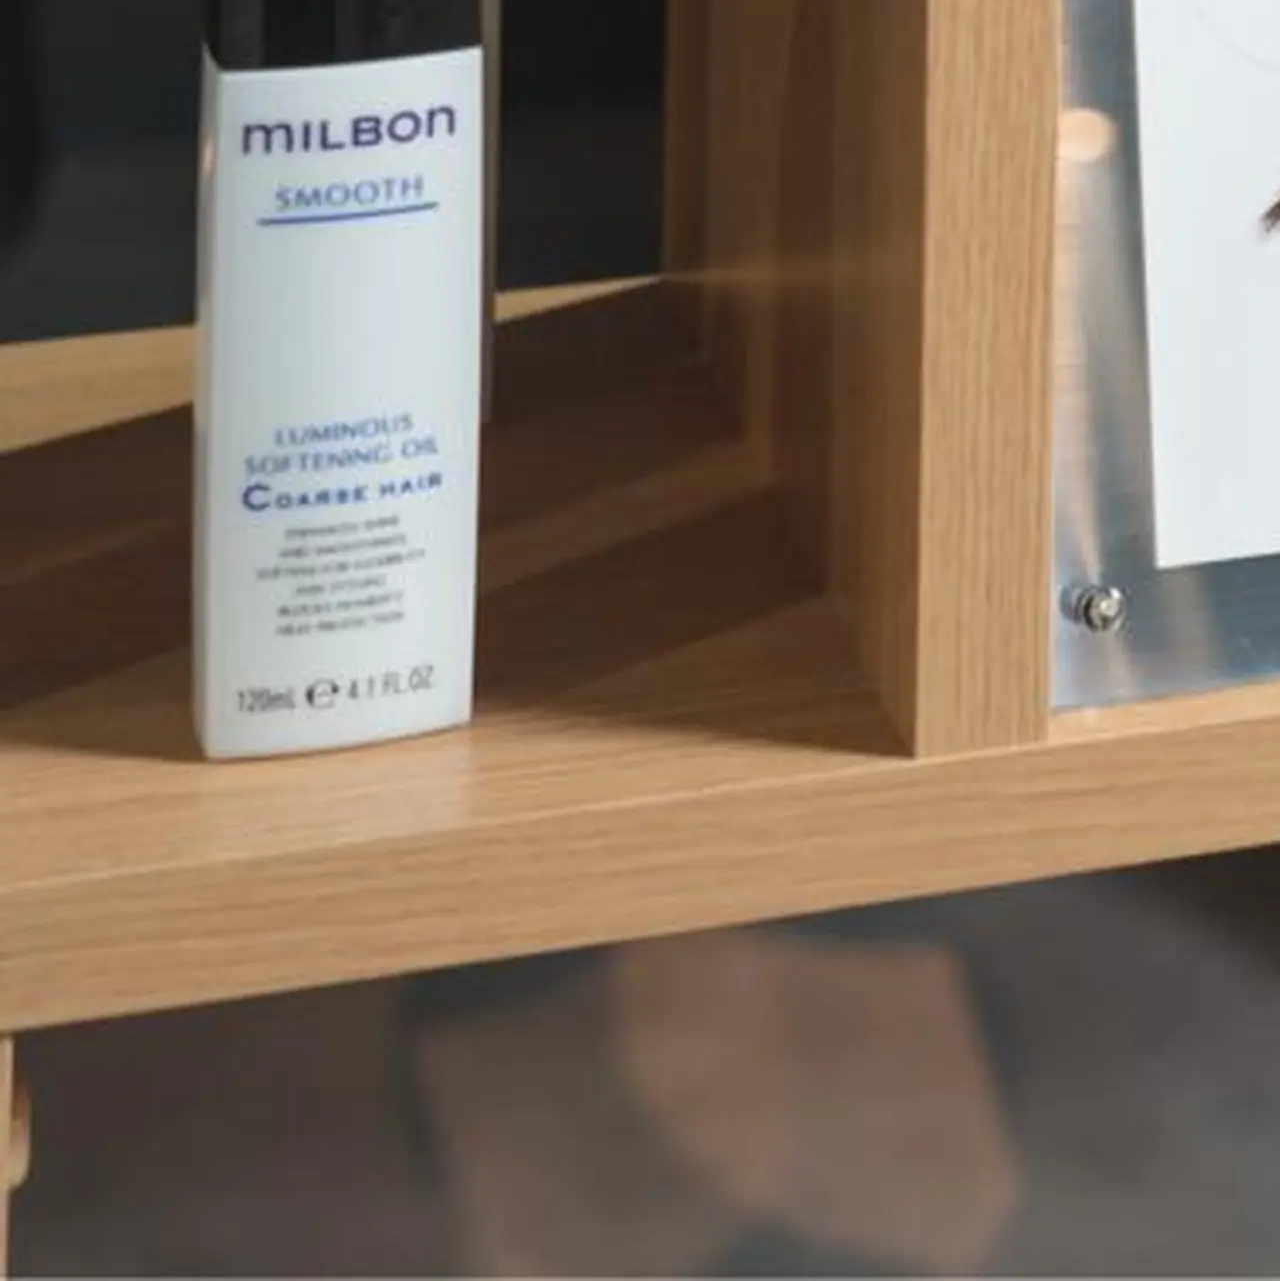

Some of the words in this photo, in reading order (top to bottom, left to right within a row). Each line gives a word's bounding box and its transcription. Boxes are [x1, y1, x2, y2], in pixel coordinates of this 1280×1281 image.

[273, 174, 425, 213] SMOOTH
[273, 411, 414, 447] LUMINOUS
[243, 443, 393, 477] SOFTENING
[400, 435, 439, 458] OIL
[241, 482, 369, 512] COARSE
[379, 472, 444, 499] HAIR
